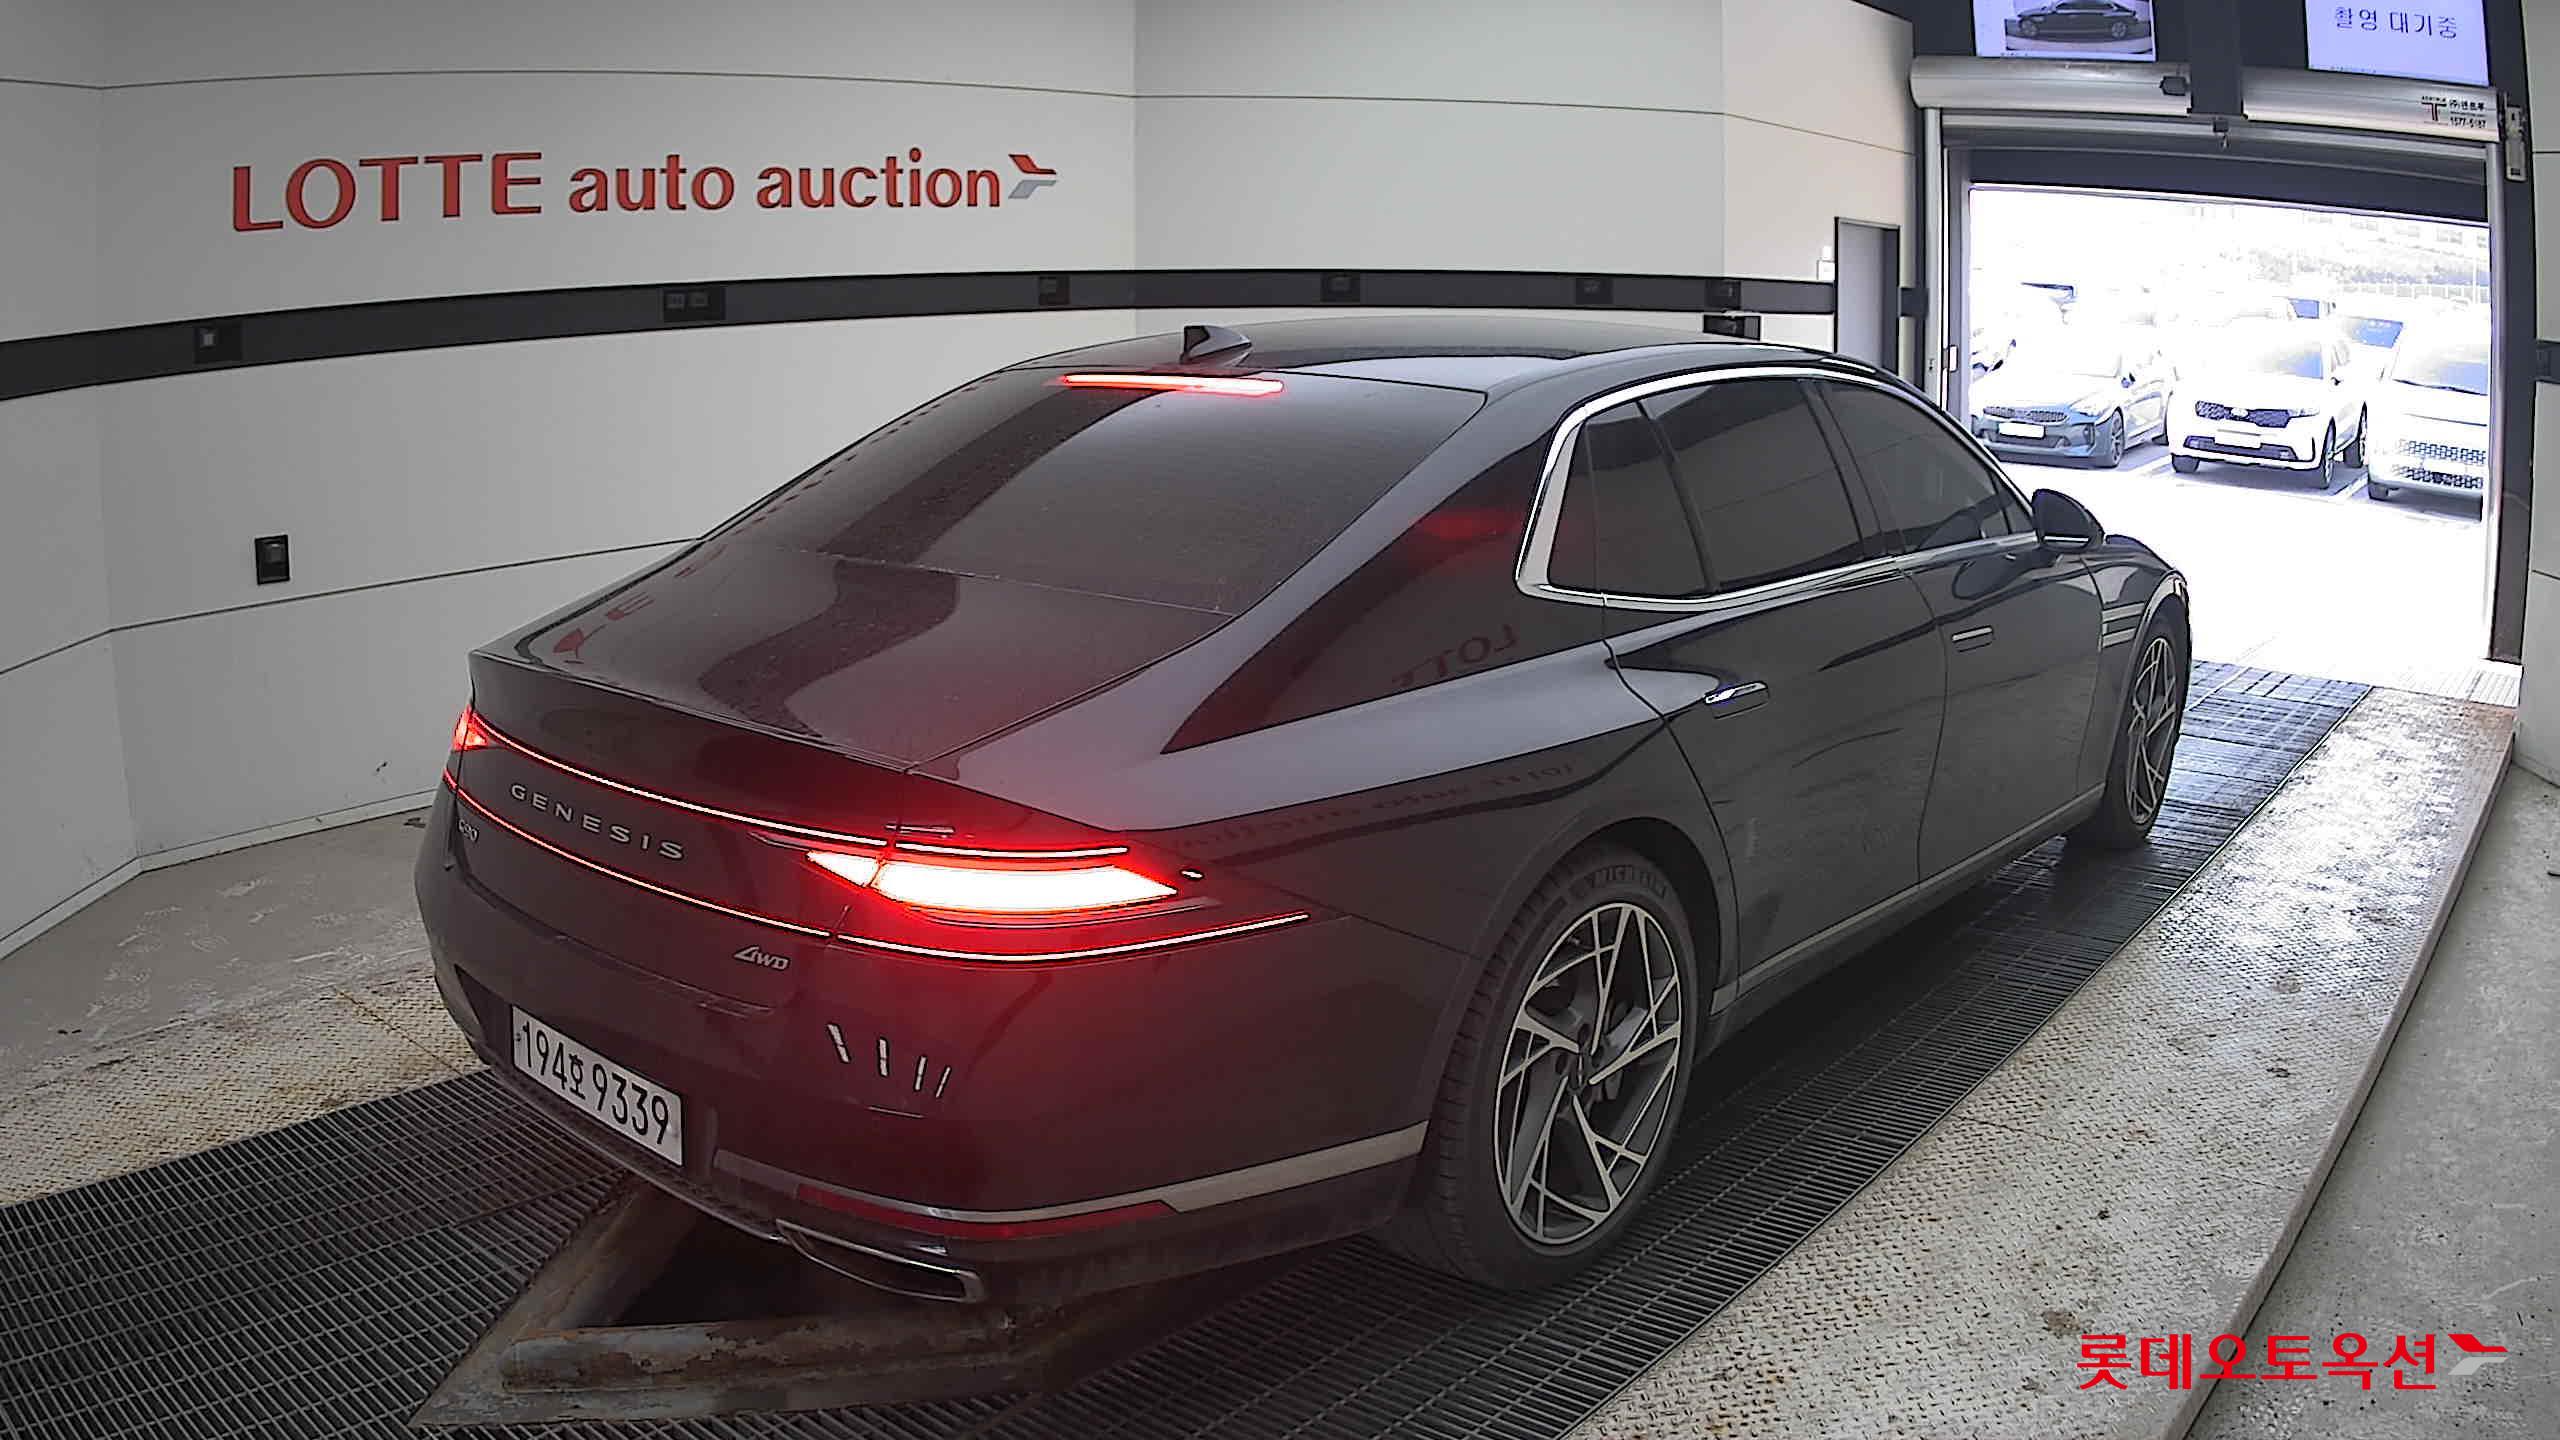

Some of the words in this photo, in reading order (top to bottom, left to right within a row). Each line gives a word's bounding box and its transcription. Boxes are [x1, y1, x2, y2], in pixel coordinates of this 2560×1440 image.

[2336, 6, 2378, 31] 촬영
[2390, 11, 2457, 39] 대기중
[232, 151, 542, 232] LOTTE
[568, 153, 735, 212] auto
[756, 147, 1001, 212] auction
[510, 783, 685, 860] GENESIS
